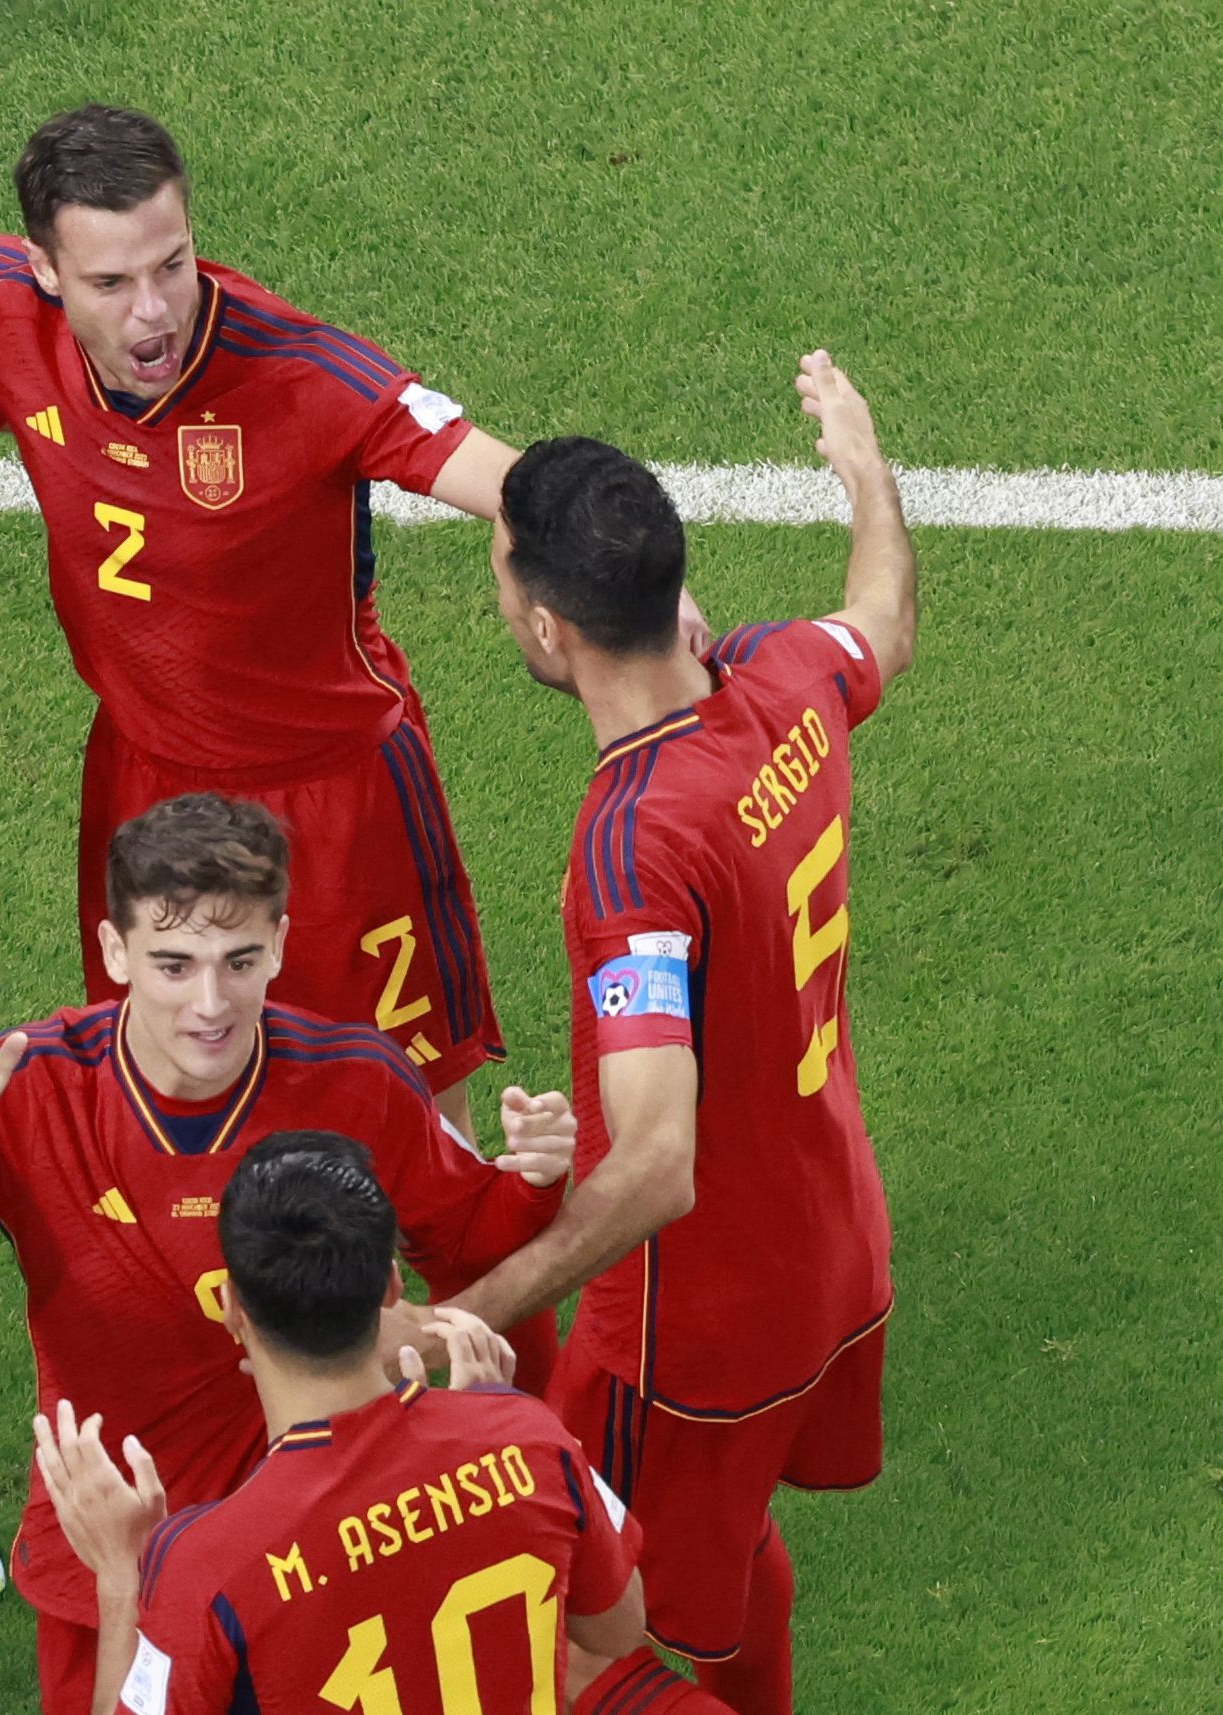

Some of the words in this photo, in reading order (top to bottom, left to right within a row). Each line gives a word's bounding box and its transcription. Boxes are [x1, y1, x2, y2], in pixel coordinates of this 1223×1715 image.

[94, 502, 152, 601] 2
[737, 707, 830, 848] SERGIO
[360, 915, 432, 1032] 2
[266, 1541, 328, 1601] M.
[338, 1444, 536, 1572] ASENSIO
